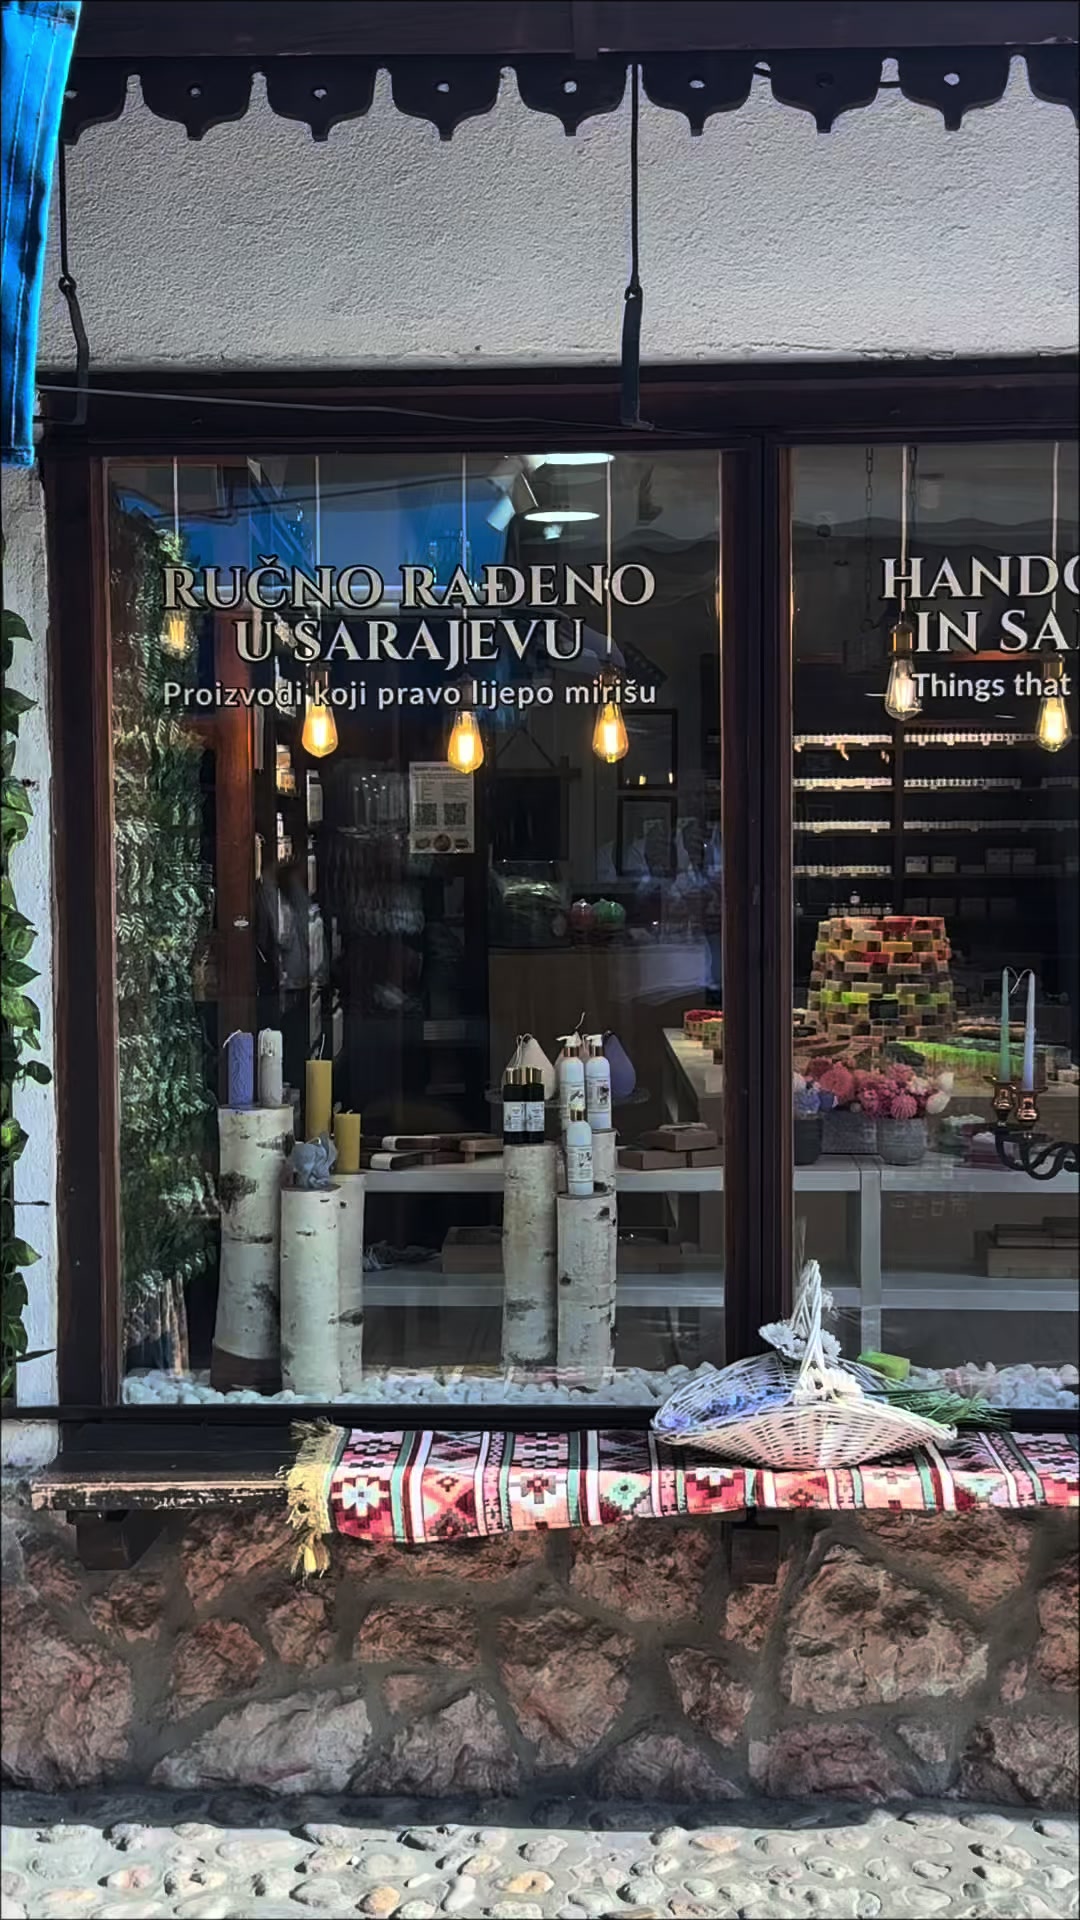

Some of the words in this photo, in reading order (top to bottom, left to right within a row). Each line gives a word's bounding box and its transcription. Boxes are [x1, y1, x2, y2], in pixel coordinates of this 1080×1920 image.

[162, 556, 384, 609] RUČNO
[400, 563, 656, 607] RAĐENO
[234, 620, 276, 661] U
[294, 618, 584, 671] SARAJEVU
[915, 610, 980, 652] IN
[1000, 609, 1079, 652] SA
[163, 681, 302, 706] Proizvodi
[314, 681, 367, 710] koji
[378, 685, 461, 710] pravo
[472, 680, 554, 710] lijepo
[565, 679, 656, 705] mirišu
[911, 672, 1005, 703] Things
[1013, 671, 1072, 696] that
